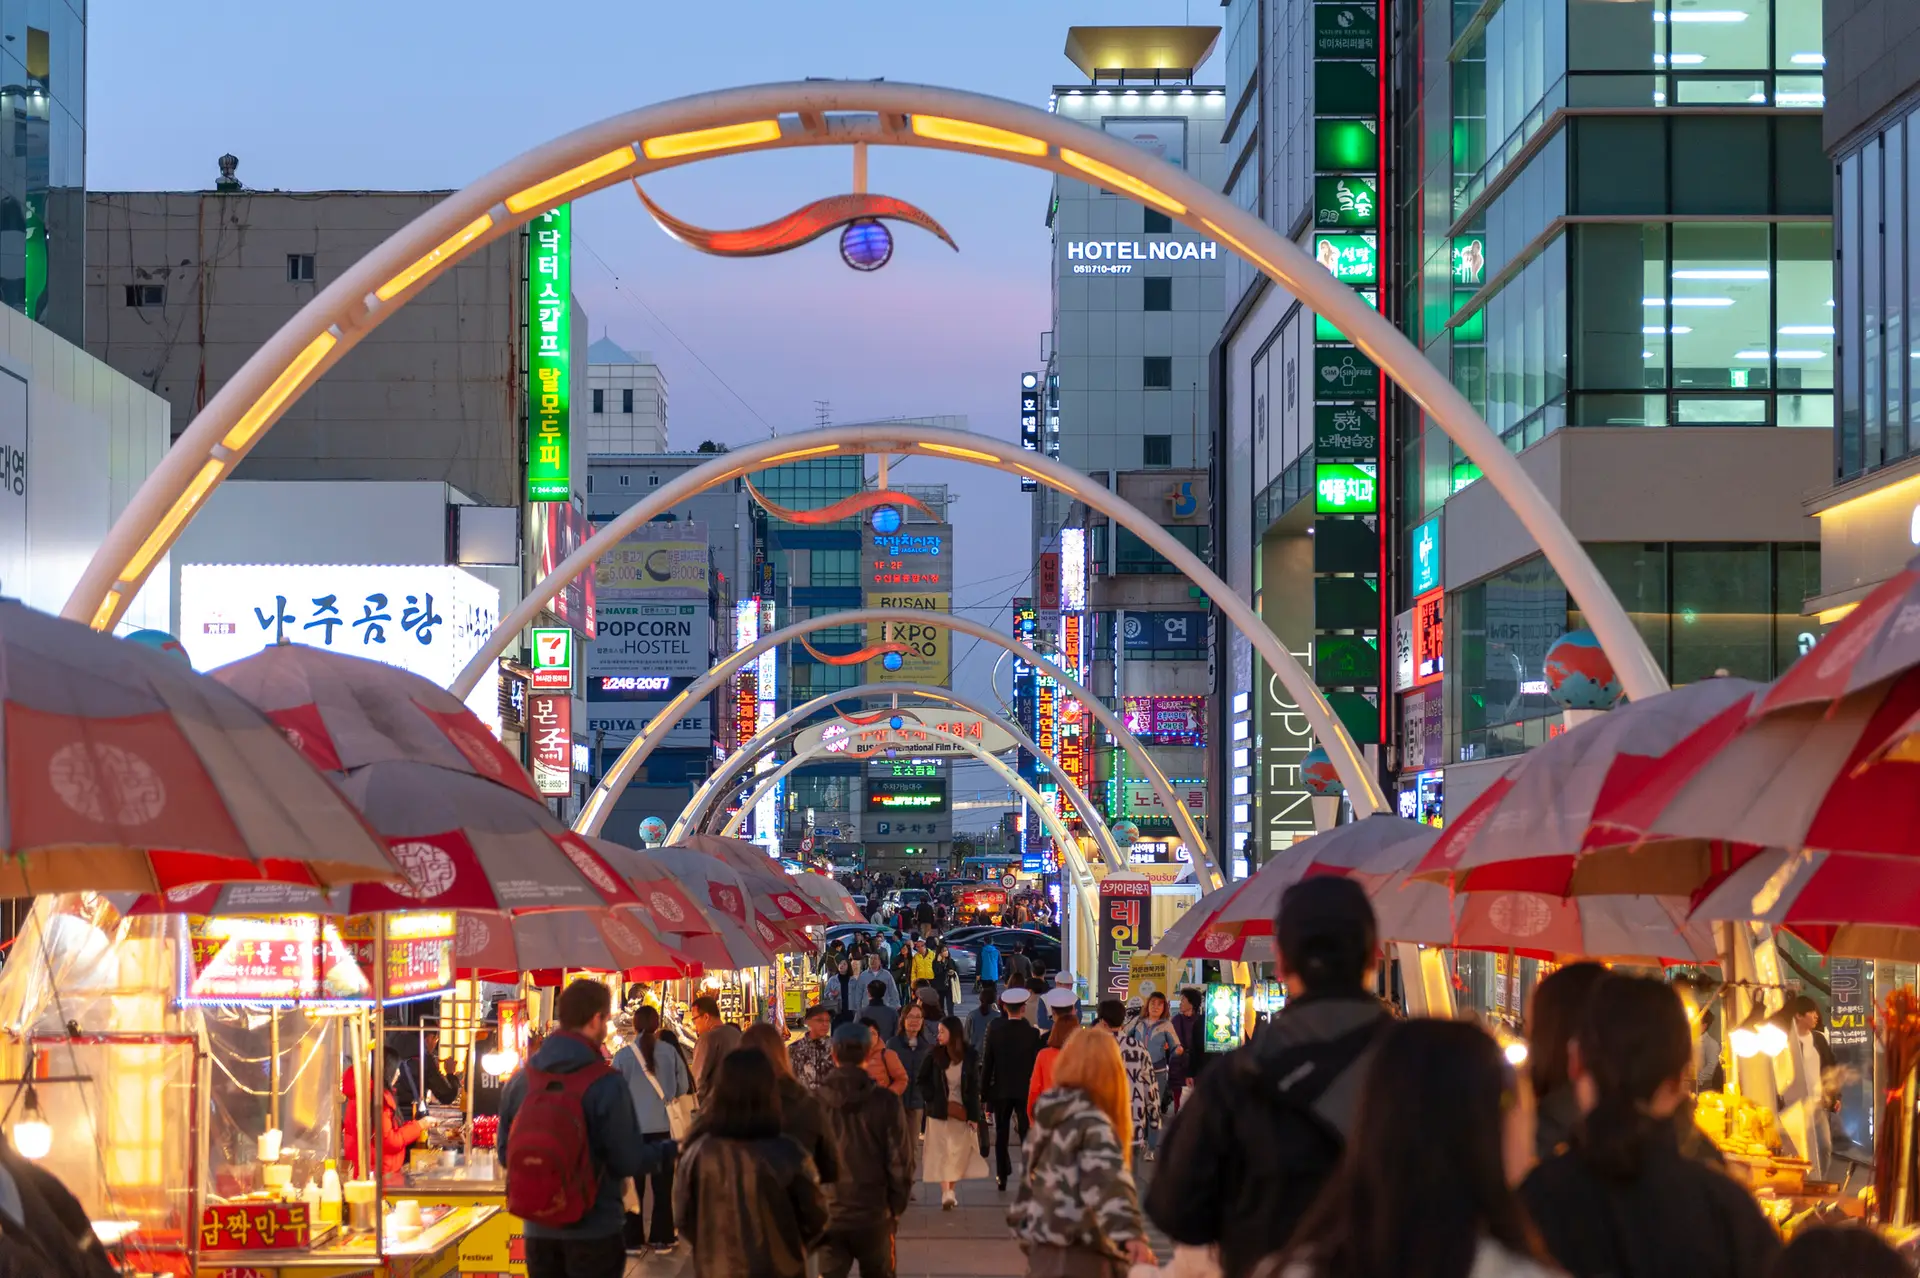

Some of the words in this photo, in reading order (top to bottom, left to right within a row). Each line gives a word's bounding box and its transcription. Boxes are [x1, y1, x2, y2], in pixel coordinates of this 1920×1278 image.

[1067, 242, 1147, 260] HOTEL
[1149, 242, 1217, 260] NOAH
[538, 230, 561, 357] 닥터스칼프
[1332, 411, 1361, 431] 동천
[1318, 434, 1376, 449] 노래연습장
[873, 532, 942, 556] 자갈치시장
[605, 607, 639, 615] NAVER
[881, 597, 936, 611] BUSAN
[253, 592, 443, 647] 나주곰탕
[596, 621, 691, 637] POPCORN
[1164, 617, 1187, 642] 연
[624, 640, 691, 655] HOSTEL
[533, 699, 570, 761] 본죽
[589, 719, 636, 731] EDIYA
[641, 718, 703, 730] CFEE
[1269, 642, 1314, 825] TOPTEN
[935, 742, 952, 751] Film
[880, 823, 888, 833] P
[1004, 877, 1013, 885] 30
[1102, 883, 1150, 895] 스카이라운지
[1108, 899, 1140, 1002] 레인보우
